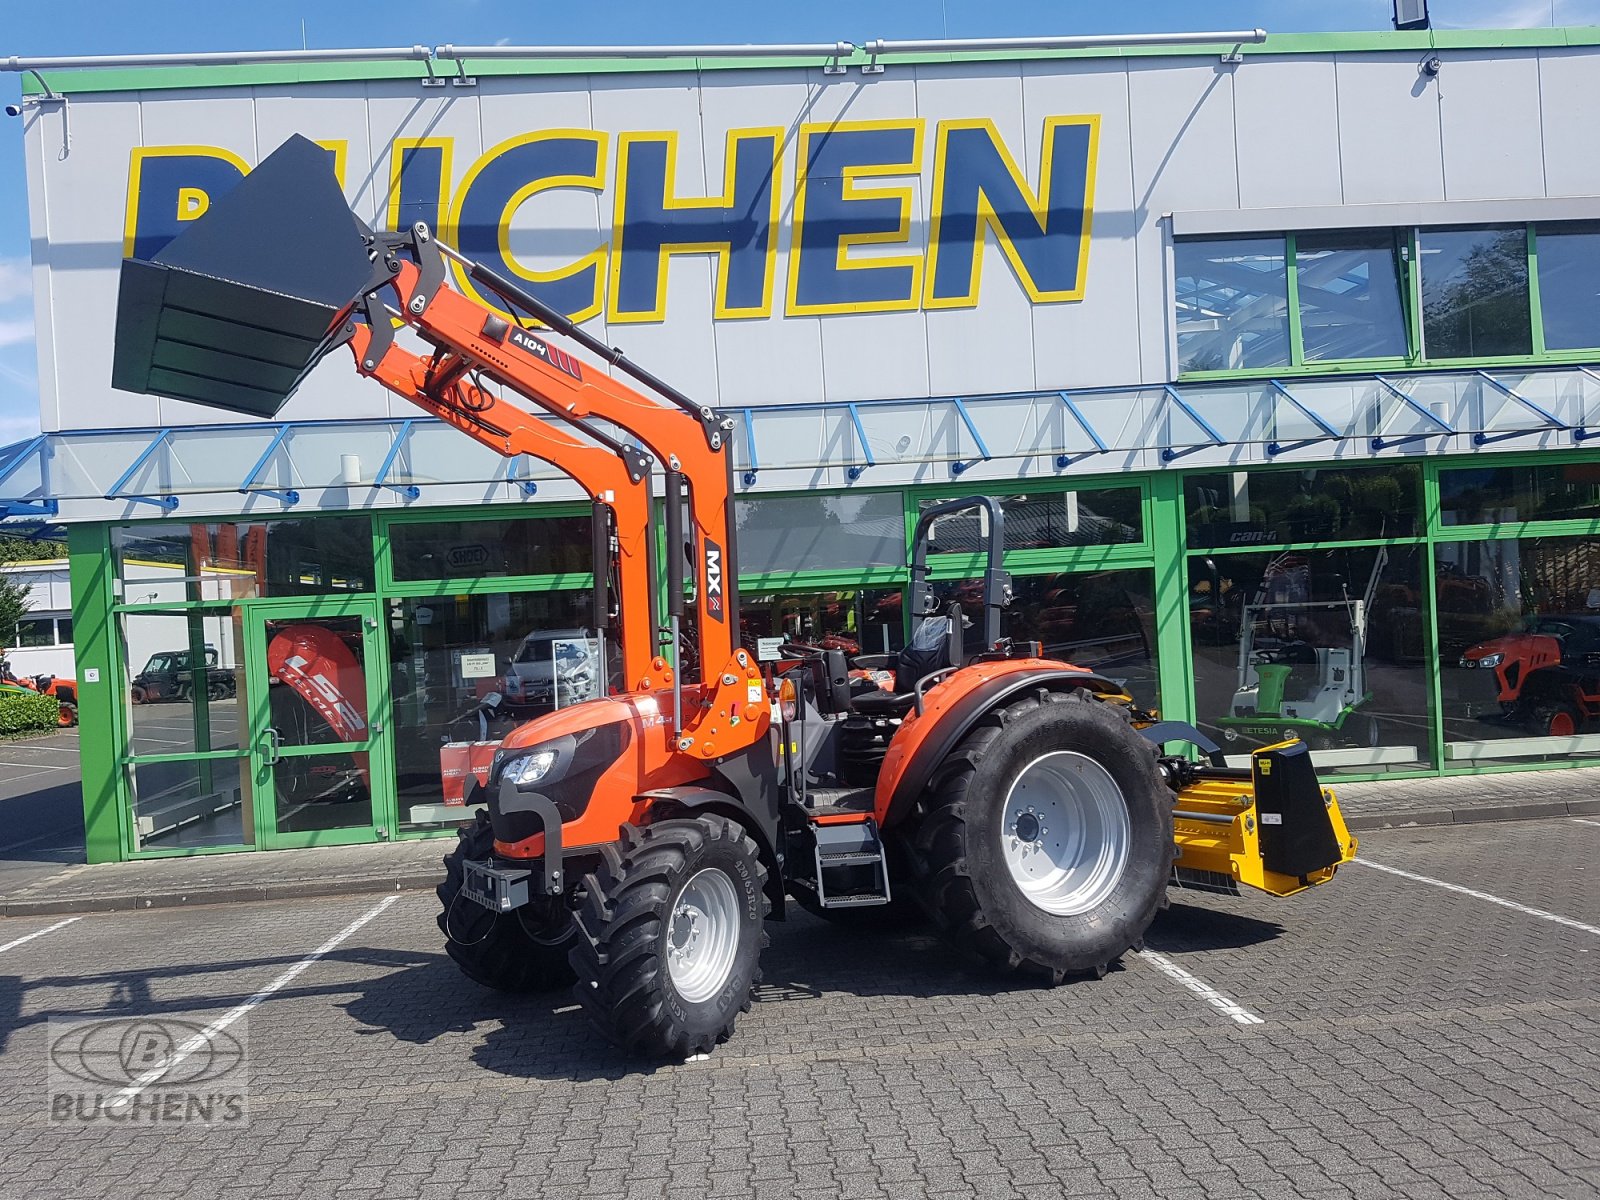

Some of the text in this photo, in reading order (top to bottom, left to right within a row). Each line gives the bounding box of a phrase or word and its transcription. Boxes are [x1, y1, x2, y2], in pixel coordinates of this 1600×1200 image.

[513, 333, 547, 356] A104
[706, 550, 721, 595] MX
[1247, 727, 1278, 735] ETESIA
[734, 859, 758, 921] 420/65R20
